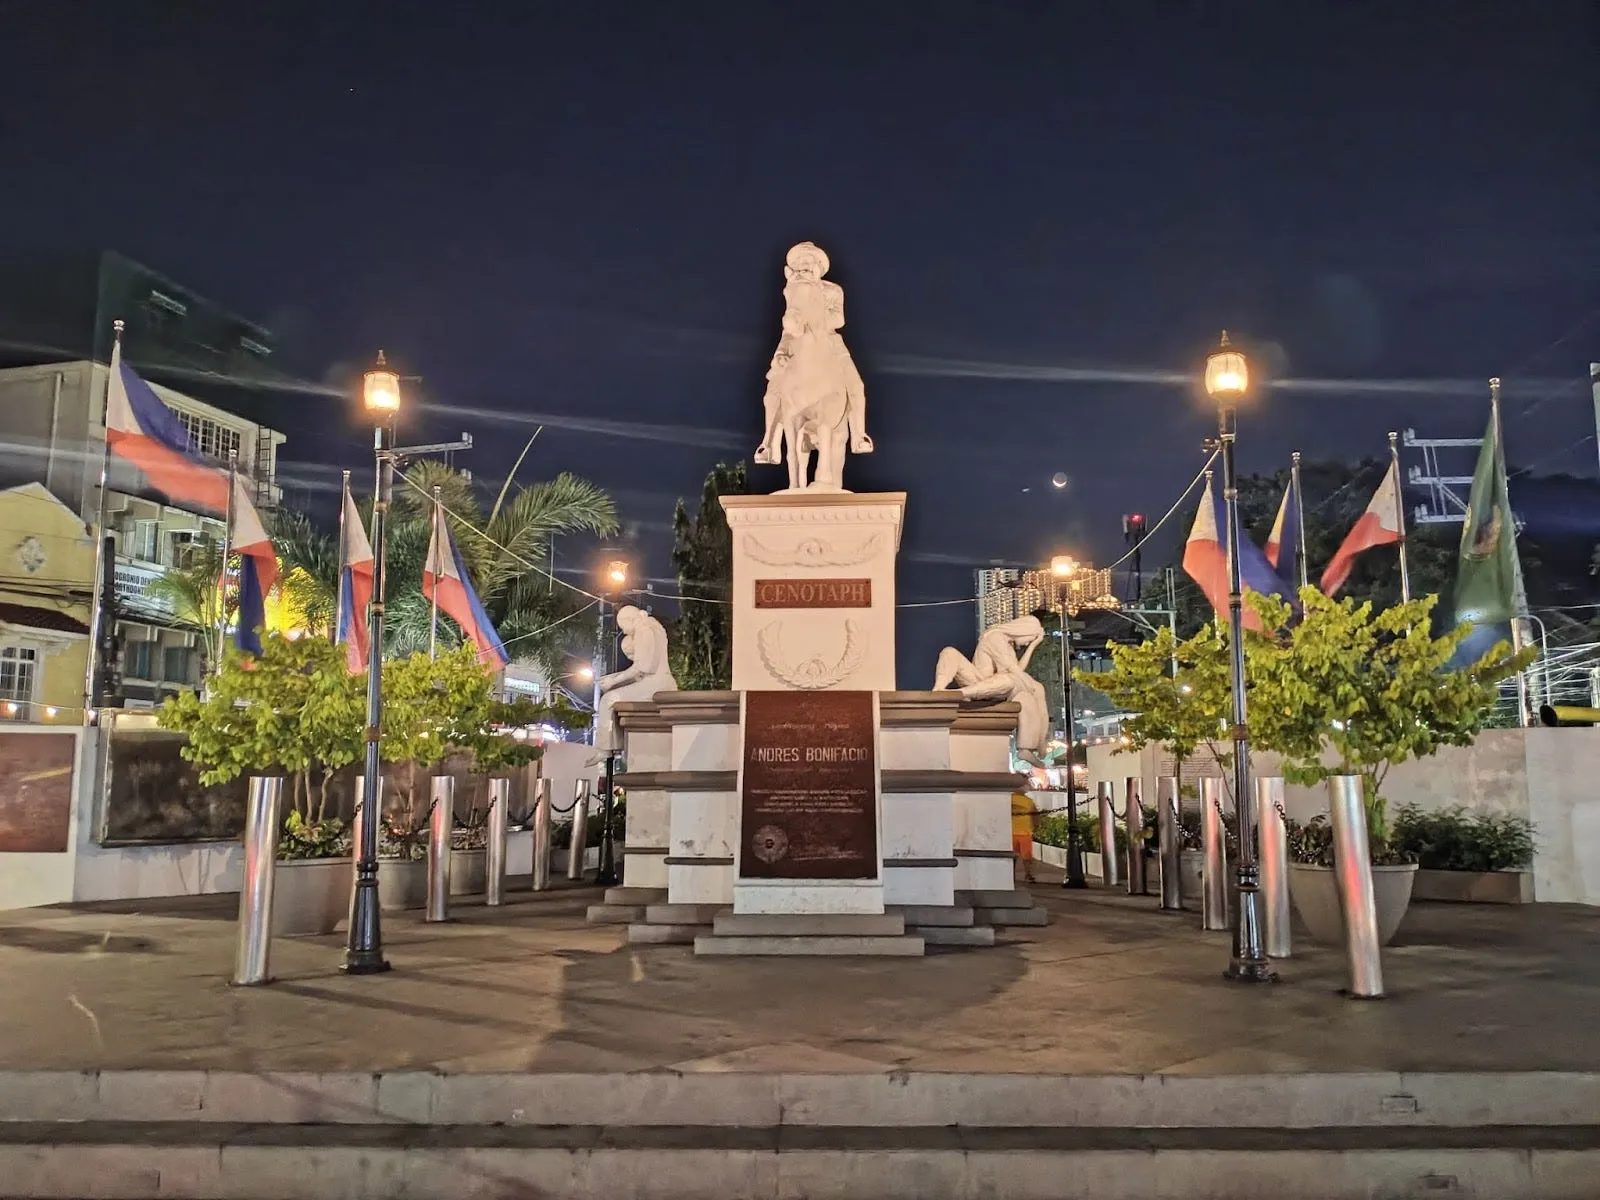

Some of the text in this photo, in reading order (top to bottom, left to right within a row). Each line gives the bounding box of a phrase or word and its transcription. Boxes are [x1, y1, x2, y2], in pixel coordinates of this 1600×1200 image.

[761, 583, 865, 602] CENOTAPH
[751, 747, 868, 762] ANDRES BONIFACIO
